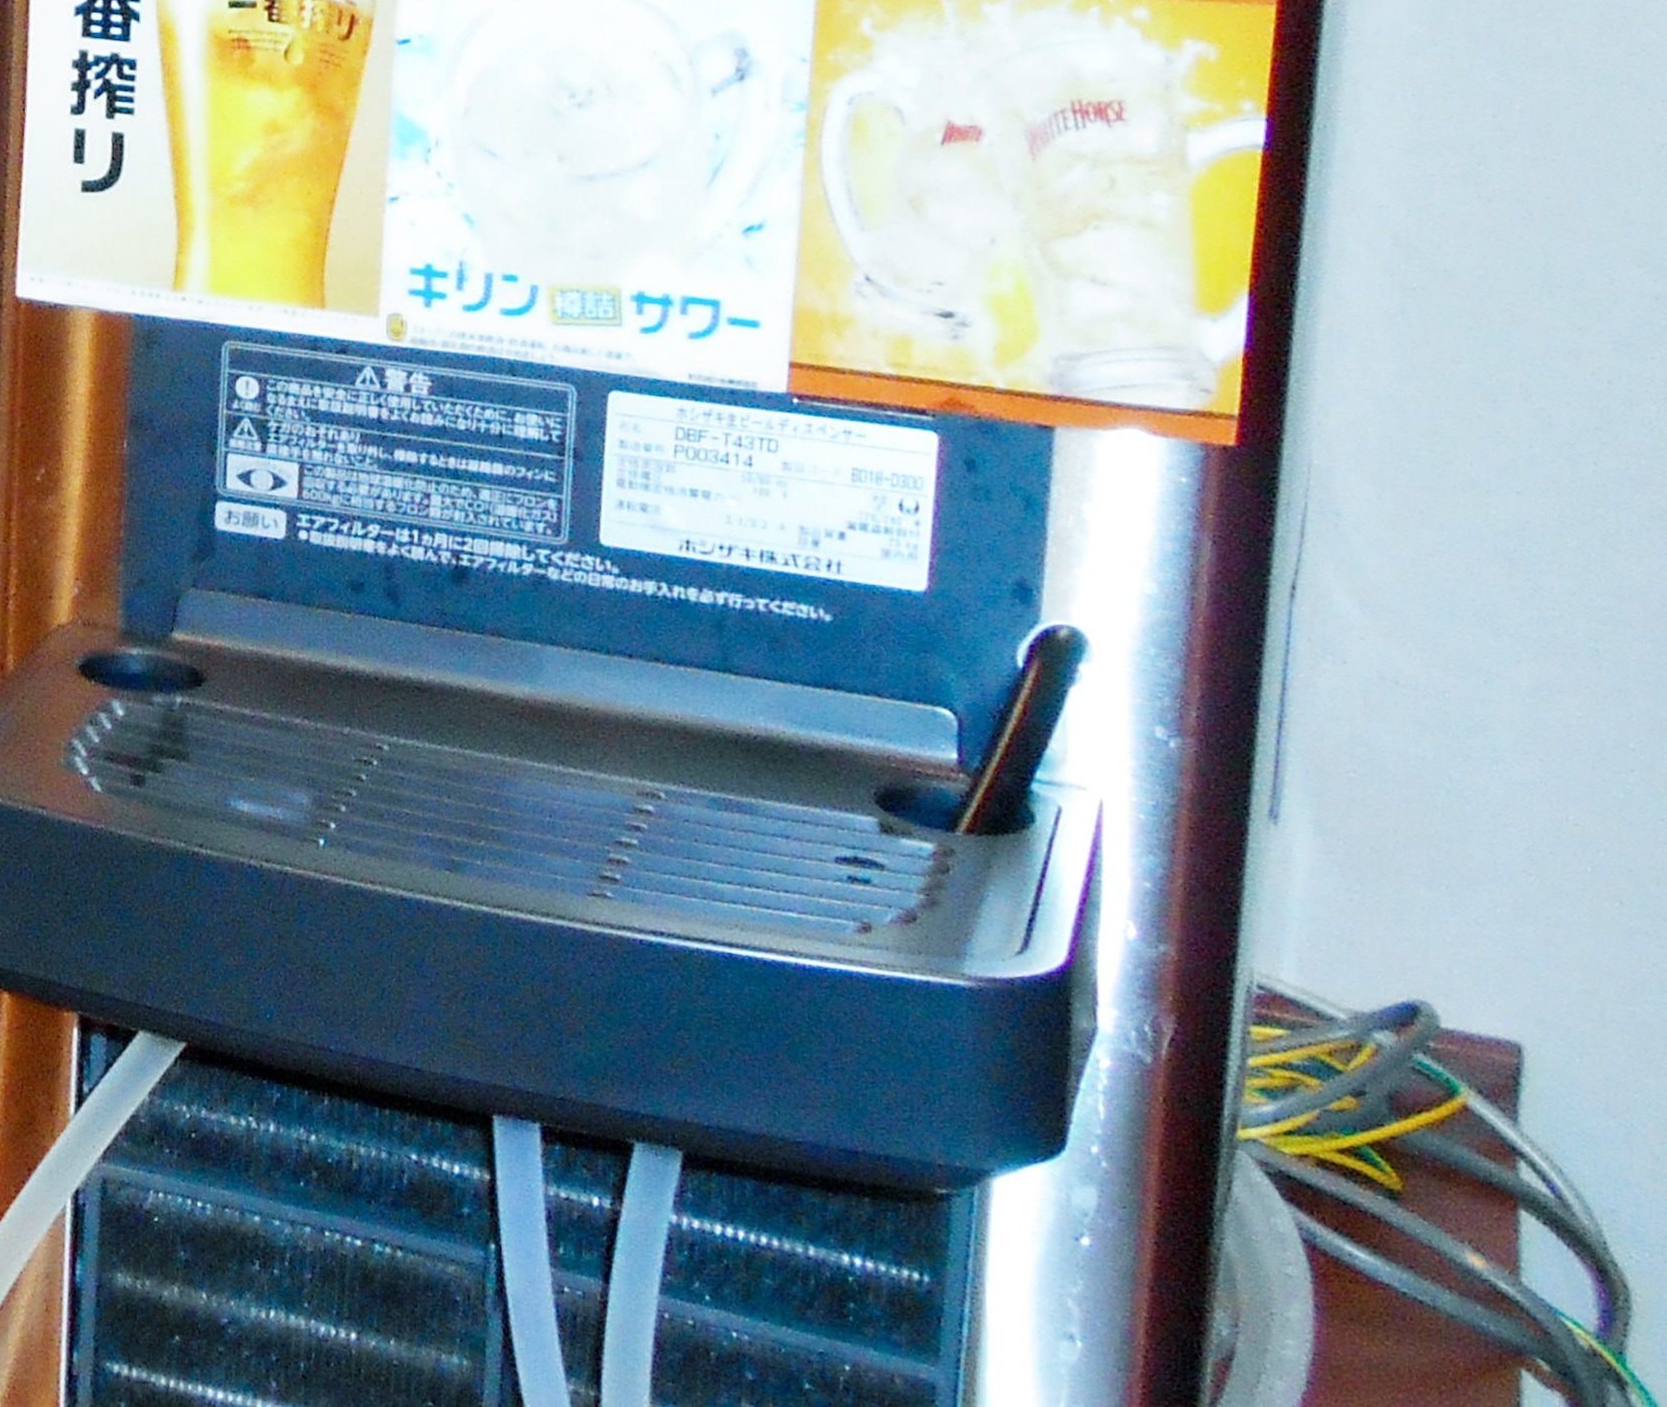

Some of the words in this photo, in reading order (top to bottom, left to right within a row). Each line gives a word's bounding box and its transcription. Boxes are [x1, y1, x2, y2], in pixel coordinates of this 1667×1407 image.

[408, 261, 539, 317] キリン
[630, 289, 761, 340] サワー
[385, 368, 433, 395] 警告
[674, 426, 779, 453] DBF-T43TD
[673, 444, 755, 468] P003414
[223, 509, 279, 531] お願い
[677, 538, 844, 576] ホシザキ株式会社
